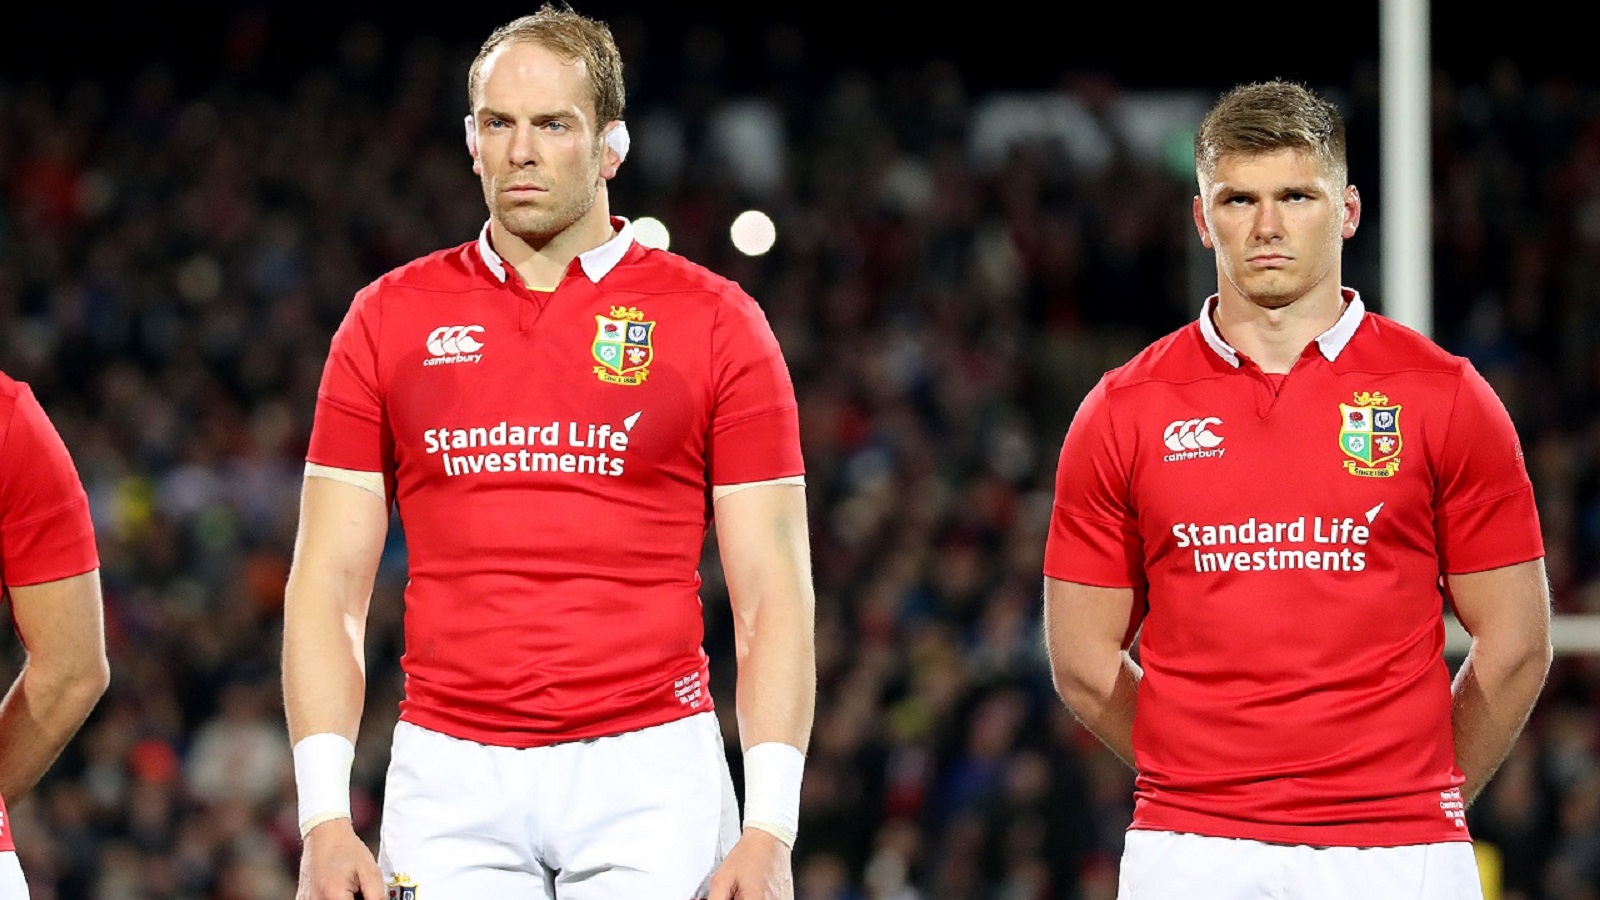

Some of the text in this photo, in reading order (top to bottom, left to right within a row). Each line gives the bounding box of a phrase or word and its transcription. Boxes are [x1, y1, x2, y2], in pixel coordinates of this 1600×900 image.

[423, 352, 483, 366] canterbury
[424, 421, 629, 453] Standard Life
[442, 449, 625, 477] Investments
[1163, 447, 1226, 462] canterbury
[1172, 516, 1370, 548] Standard Life
[1194, 547, 1366, 572] Investments
